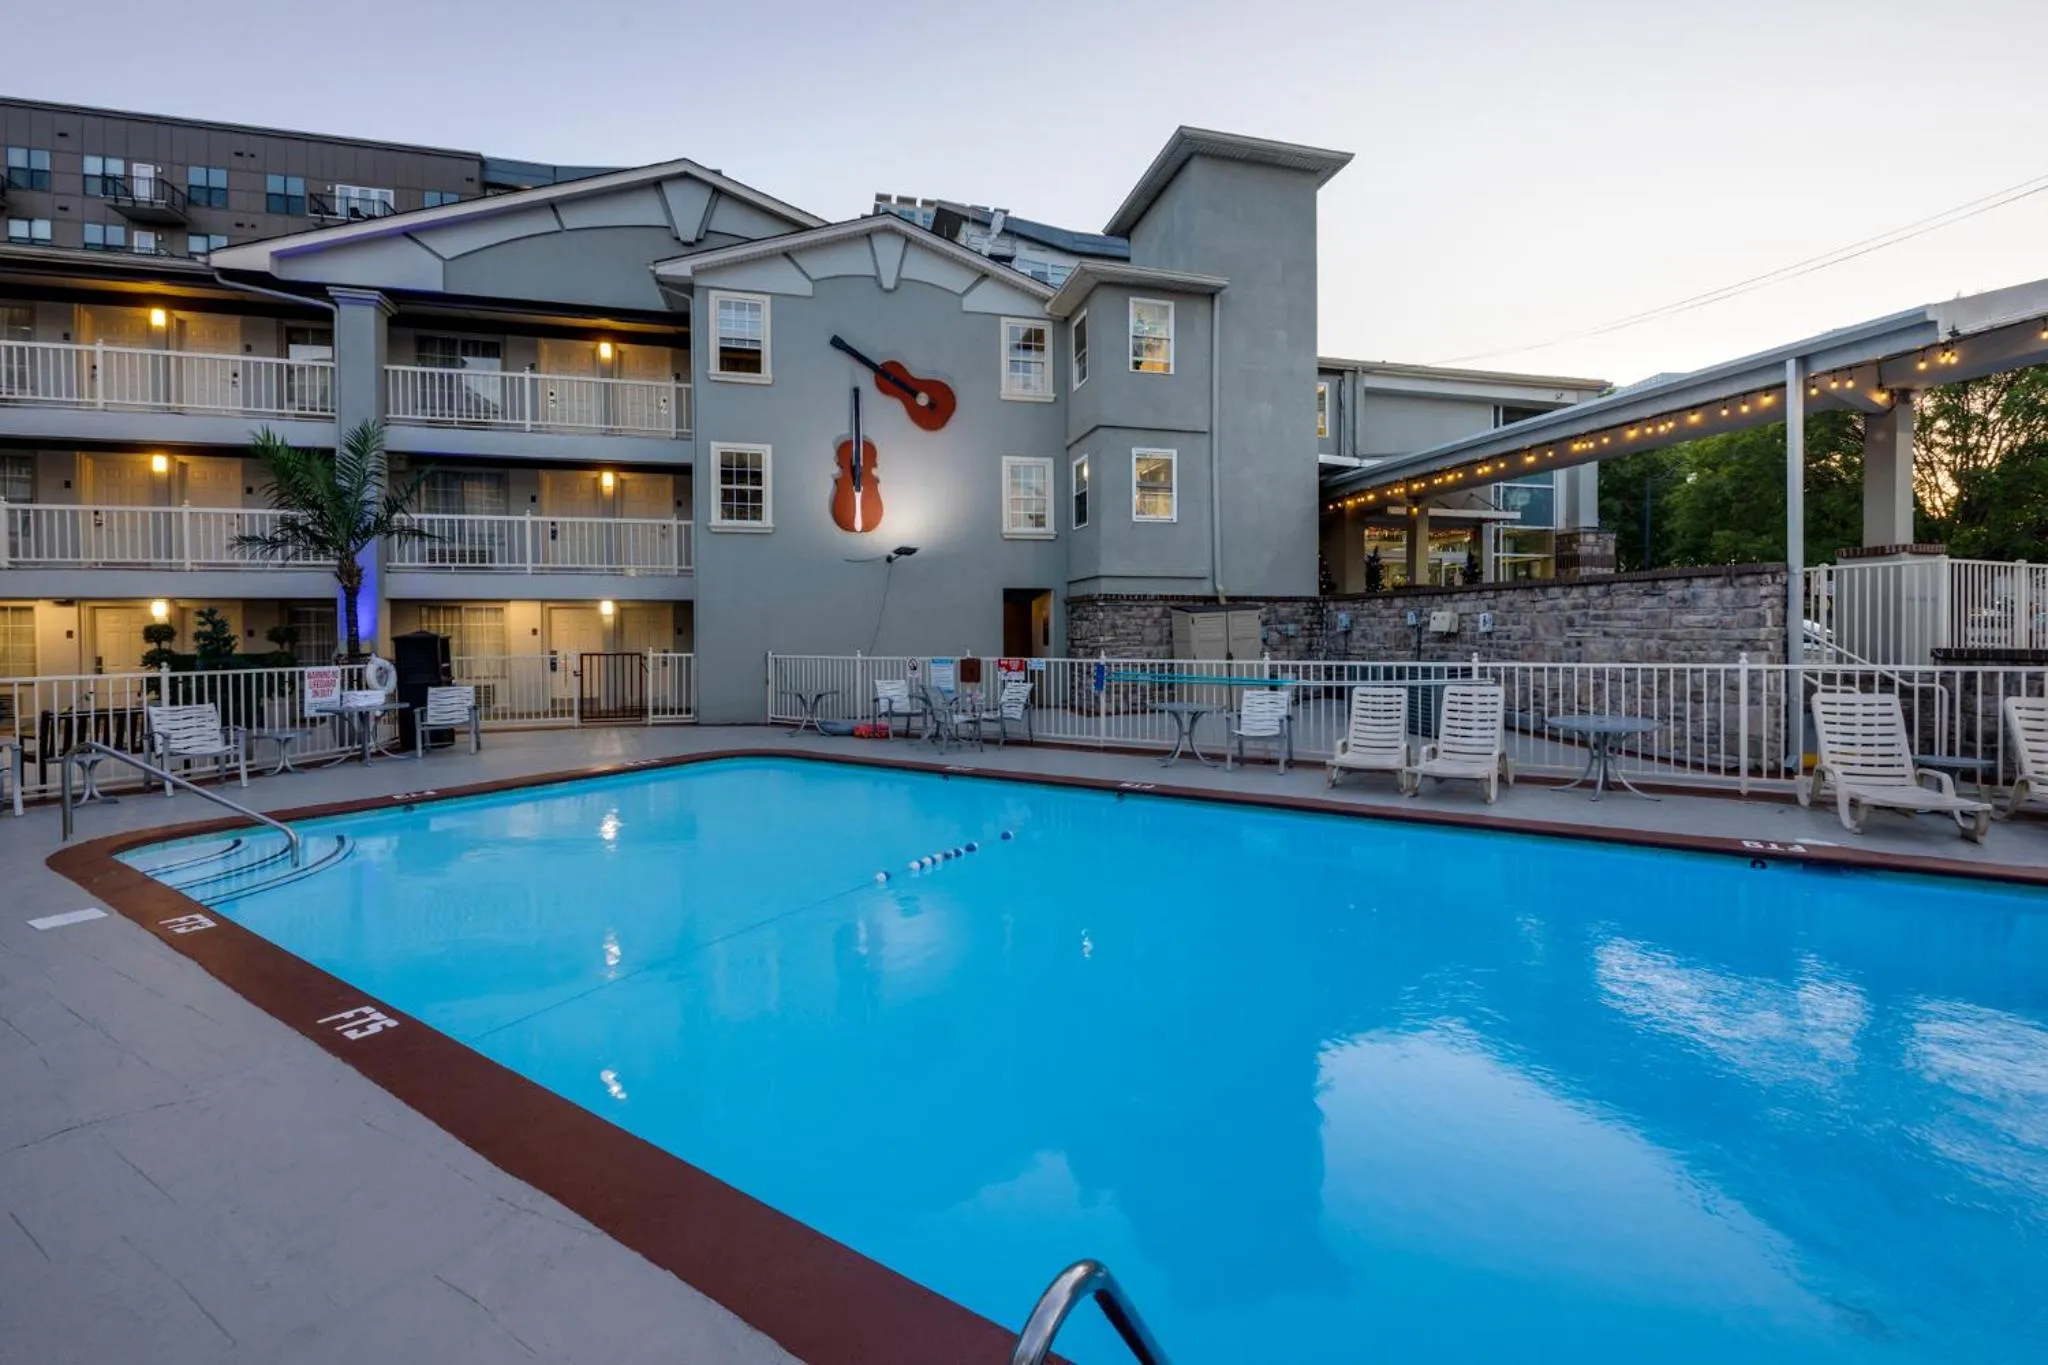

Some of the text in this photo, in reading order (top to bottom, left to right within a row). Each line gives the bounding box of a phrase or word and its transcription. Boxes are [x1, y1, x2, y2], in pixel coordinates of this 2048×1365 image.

[308, 679, 337, 689] LIFEGUARD
[312, 688, 334, 698] ON DUTY
